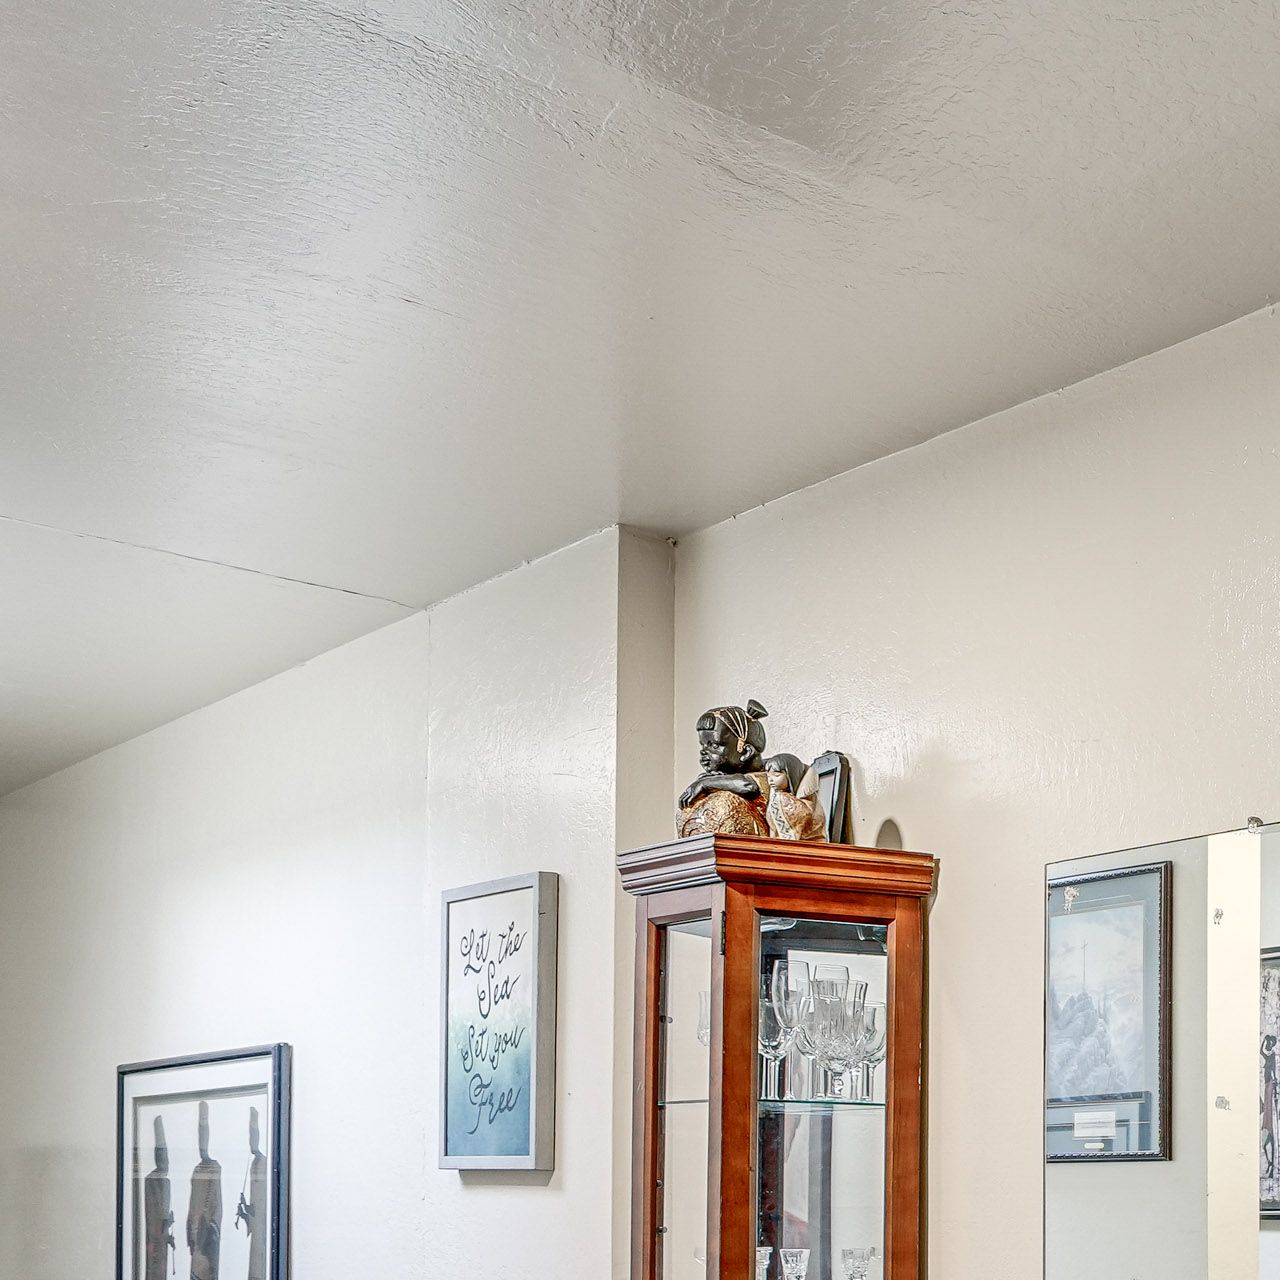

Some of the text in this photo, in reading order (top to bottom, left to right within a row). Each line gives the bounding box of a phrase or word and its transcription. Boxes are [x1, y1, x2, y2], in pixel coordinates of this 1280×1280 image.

[459, 920, 528, 977] Let the
[476, 960, 522, 1019] Sea
[489, 1025, 526, 1071] you
[466, 1072, 522, 1136] Free
